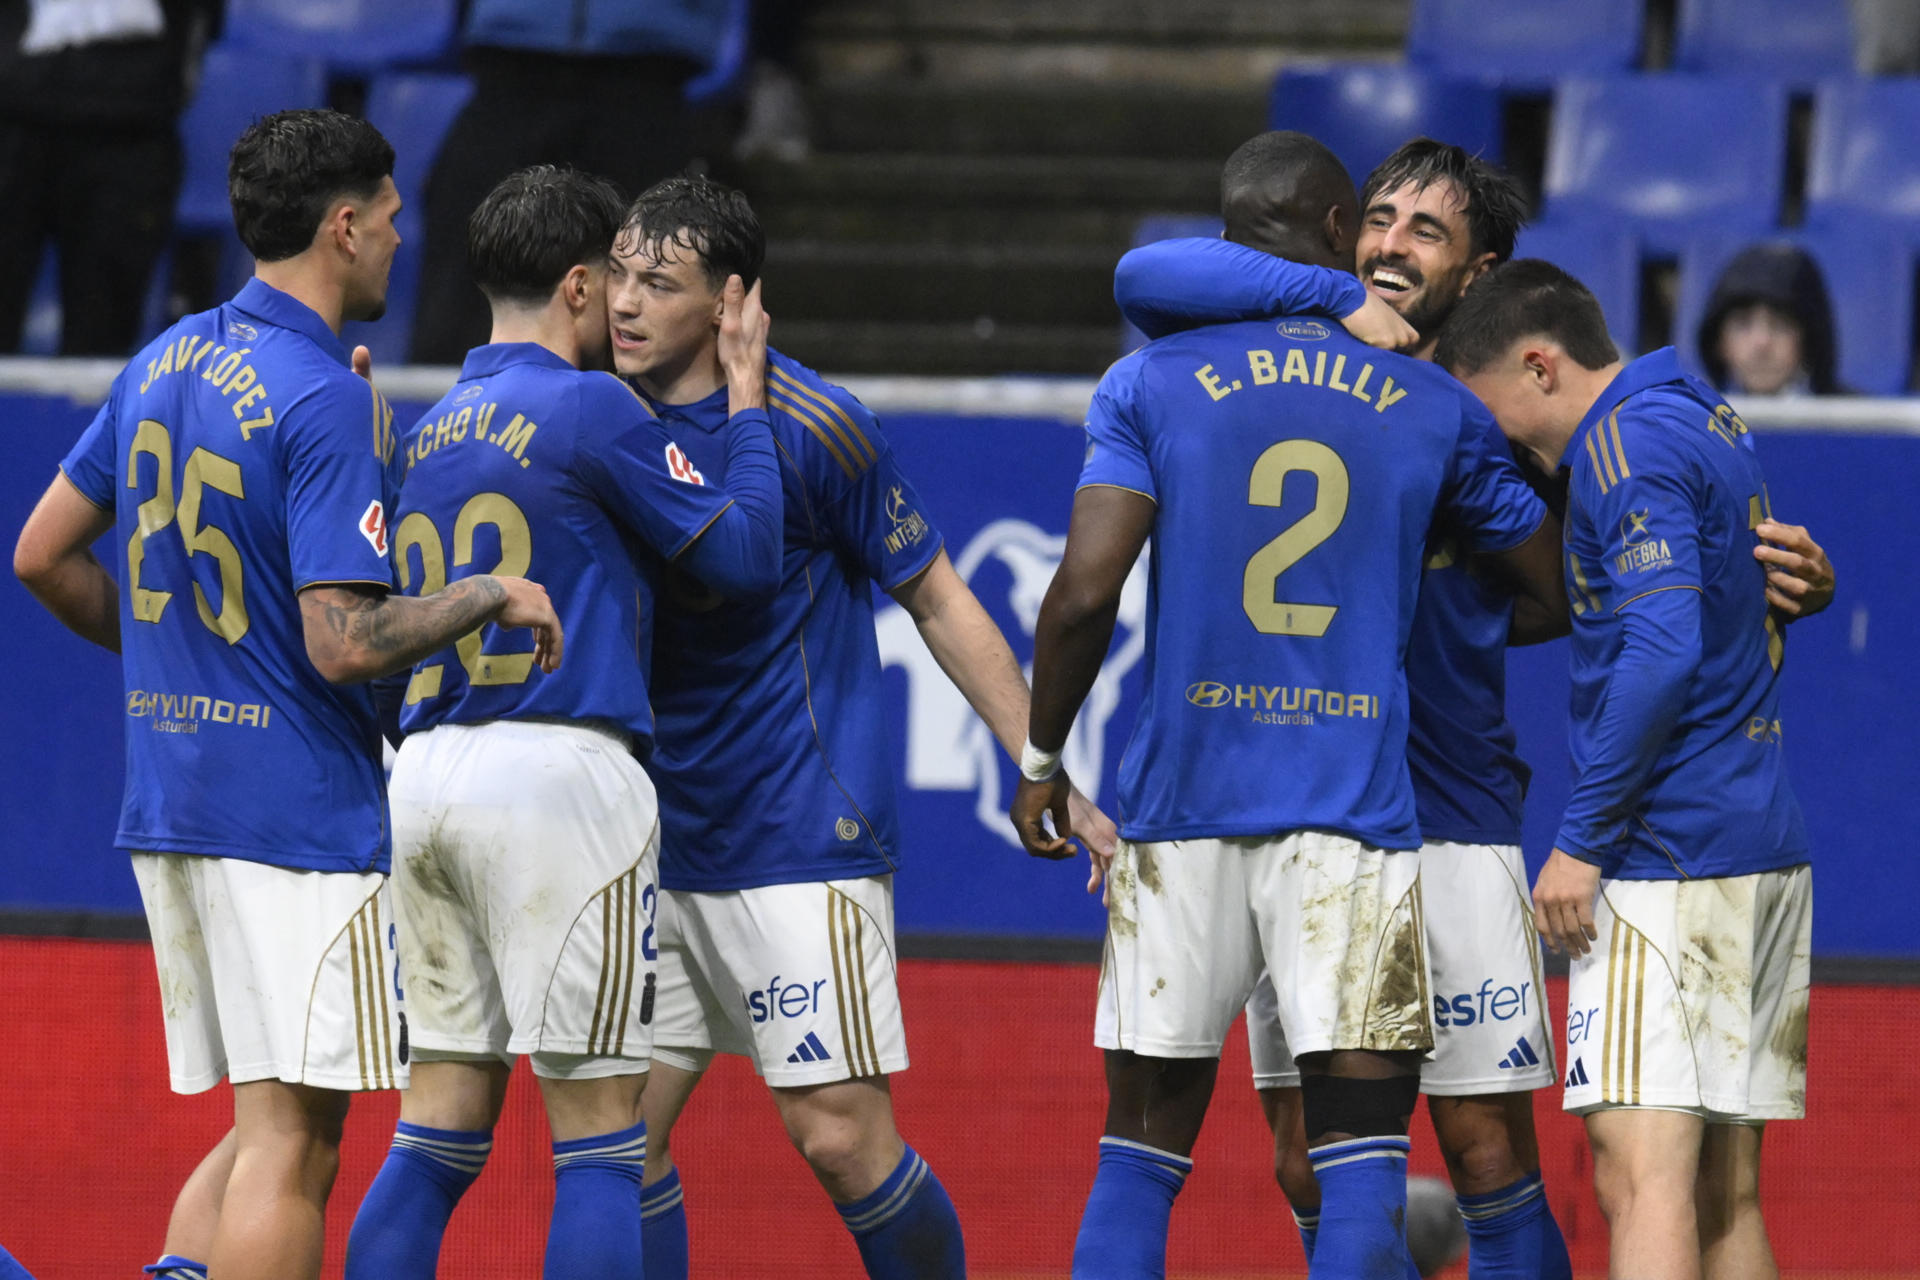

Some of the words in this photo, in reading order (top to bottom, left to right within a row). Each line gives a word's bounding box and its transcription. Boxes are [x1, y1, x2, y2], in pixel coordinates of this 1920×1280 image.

[140, 335, 215, 394] JAVI
[201, 347, 274, 441] LÓPEZ
[1194, 363, 1242, 402] E.
[1247, 349, 1408, 413] BAILLY
[475, 402, 537, 469] V.M.
[127, 418, 249, 646] 25
[1242, 438, 1350, 637] 2
[1614, 538, 1672, 576] INTEGRA
[395, 492, 534, 706] 22
[146, 692, 270, 729] HYUNDAI
[1235, 684, 1379, 719] HYUNDAI
[1252, 710, 1314, 726] Asturdai
[743, 975, 827, 1023] sfer
